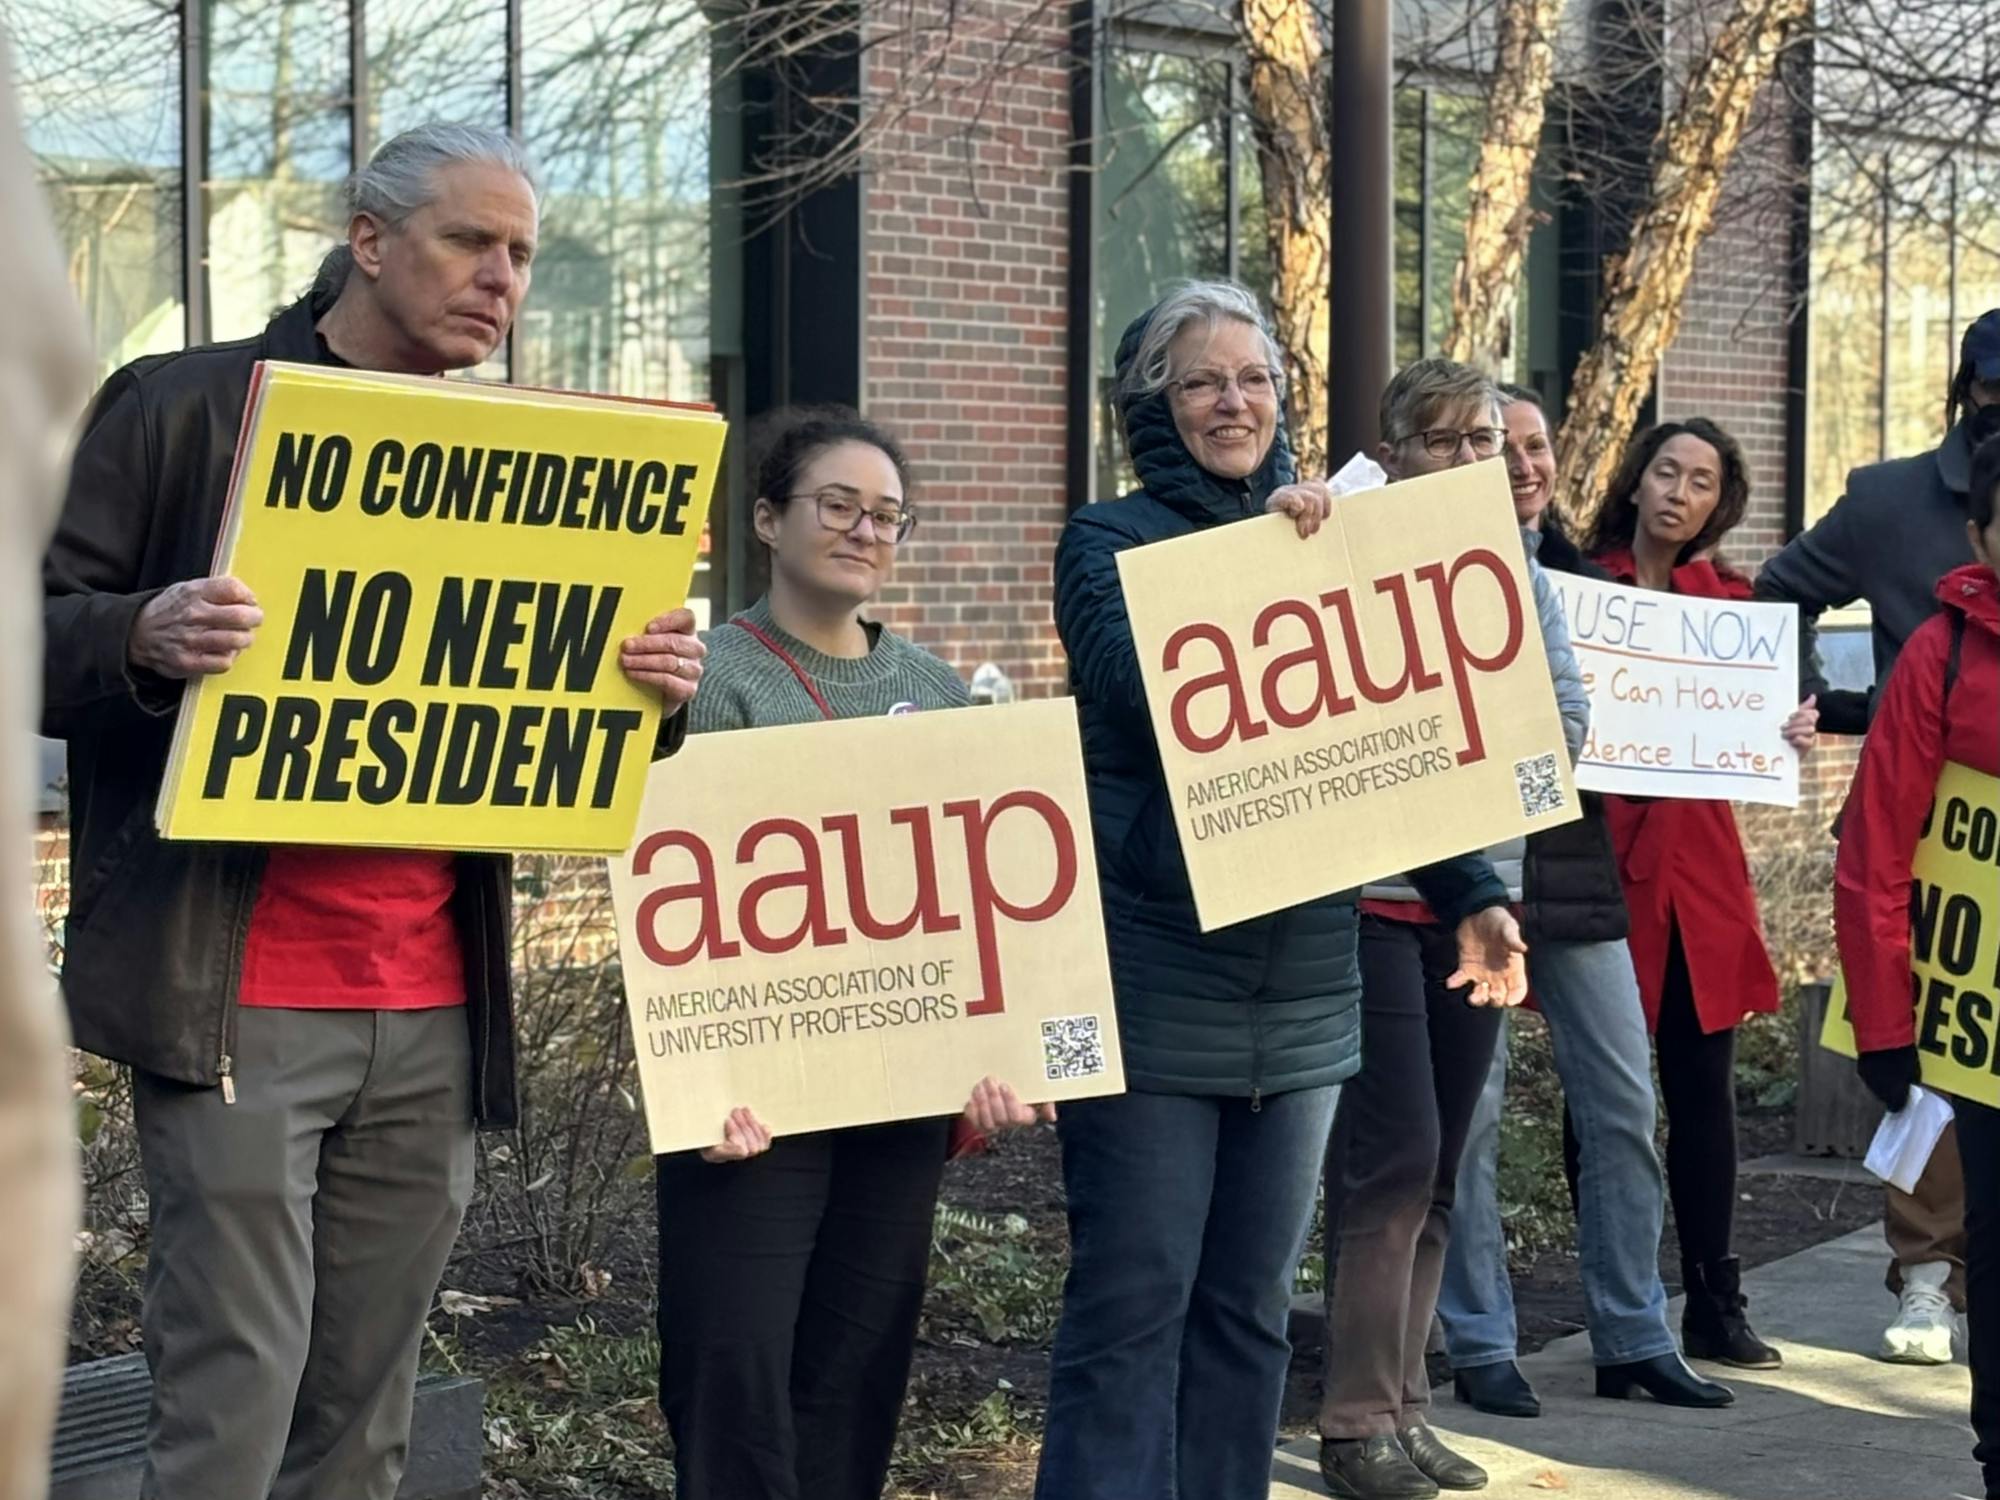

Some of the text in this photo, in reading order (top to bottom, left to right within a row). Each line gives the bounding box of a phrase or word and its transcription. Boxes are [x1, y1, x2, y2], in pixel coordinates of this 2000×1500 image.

[264, 431, 697, 536] NO CONFIDENCE
[281, 568, 623, 692] NO NEW
[1162, 548, 1524, 766] aaup
[1682, 609, 1787, 662] NOW
[1580, 658, 1765, 711] e Can Have
[201, 694, 642, 809] PRESIDENT
[1186, 715, 1443, 810] AMERICAN ASSOCIATION OF
[1191, 747, 1452, 841] UNIVERSITY PROFESSORS
[1582, 727, 1785, 774] dence Later
[1942, 796, 2000, 867] CO
[632, 790, 1077, 1017] aaup
[1911, 878, 1982, 977] NO
[645, 960, 954, 1022] AMERICAN ASSOCIATION OF
[648, 994, 958, 1058] UNIVERSITY PROFESSORS
